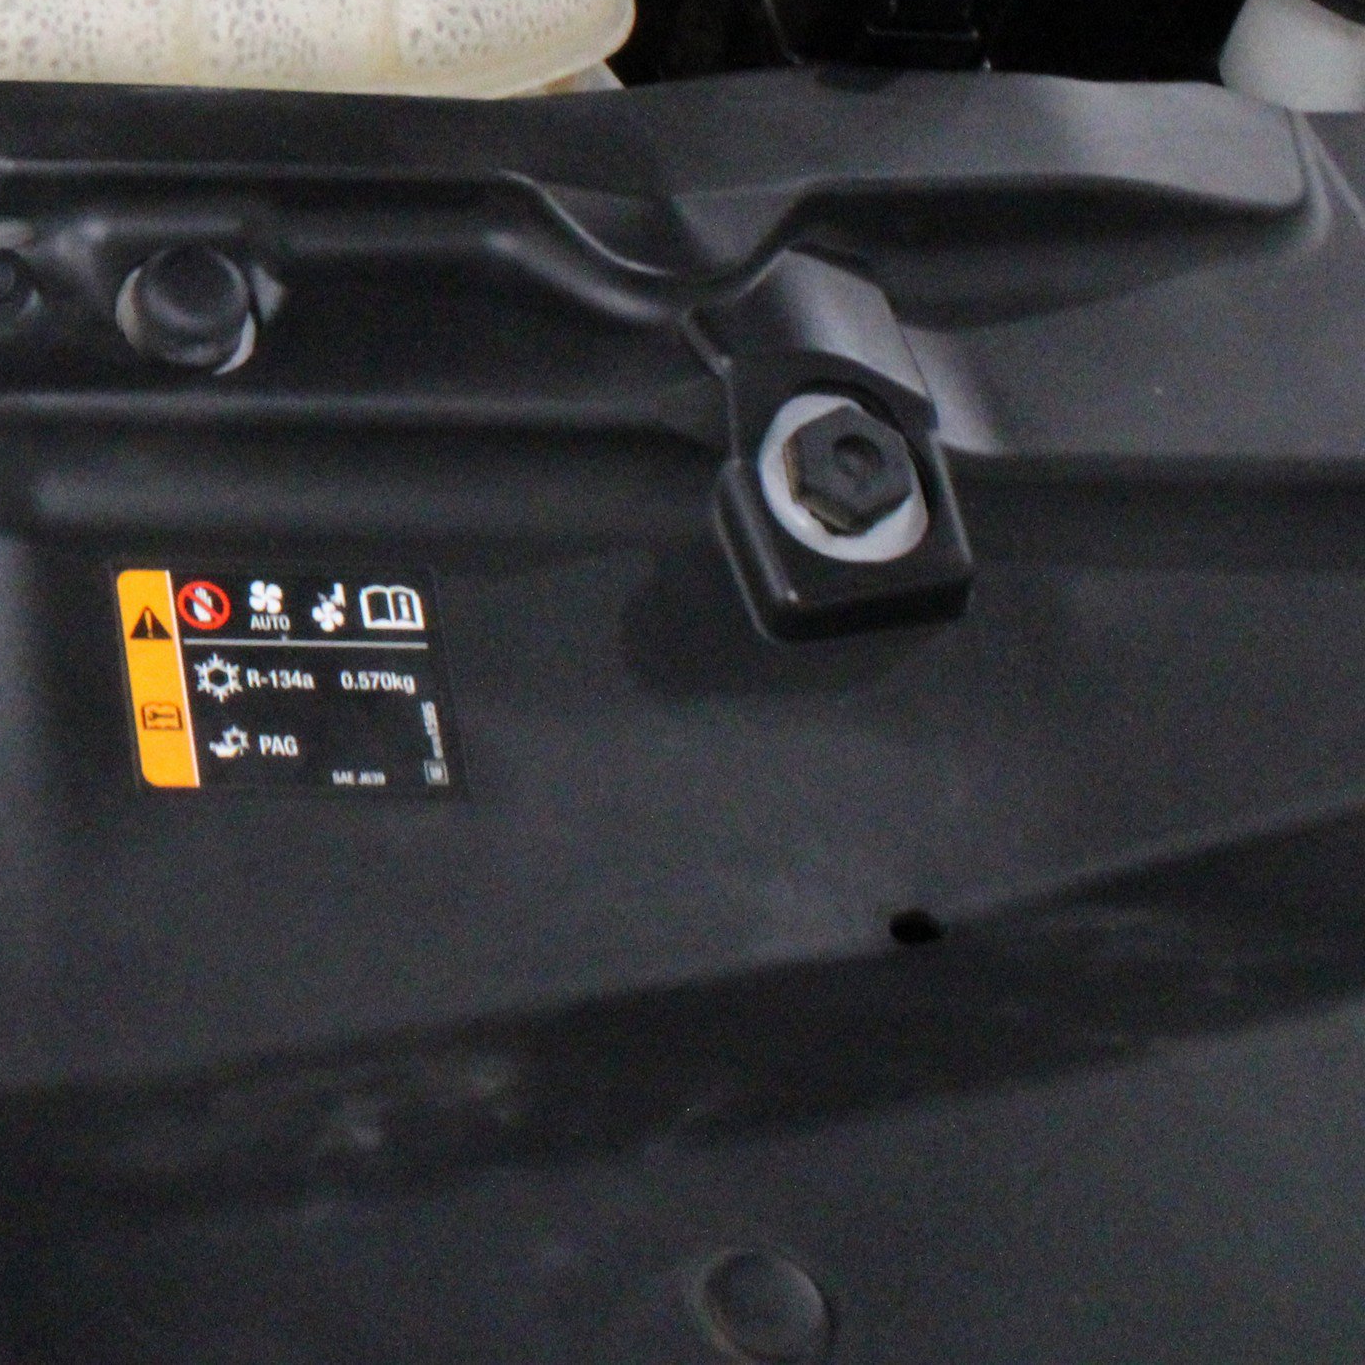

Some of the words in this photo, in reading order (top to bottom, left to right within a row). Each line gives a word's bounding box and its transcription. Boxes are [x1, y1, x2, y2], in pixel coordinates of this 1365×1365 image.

[250, 614, 290, 632] AUTO
[246, 669, 315, 690] R-134a
[340, 669, 416, 696] 0.570kg
[259, 735, 299, 756] PAG
